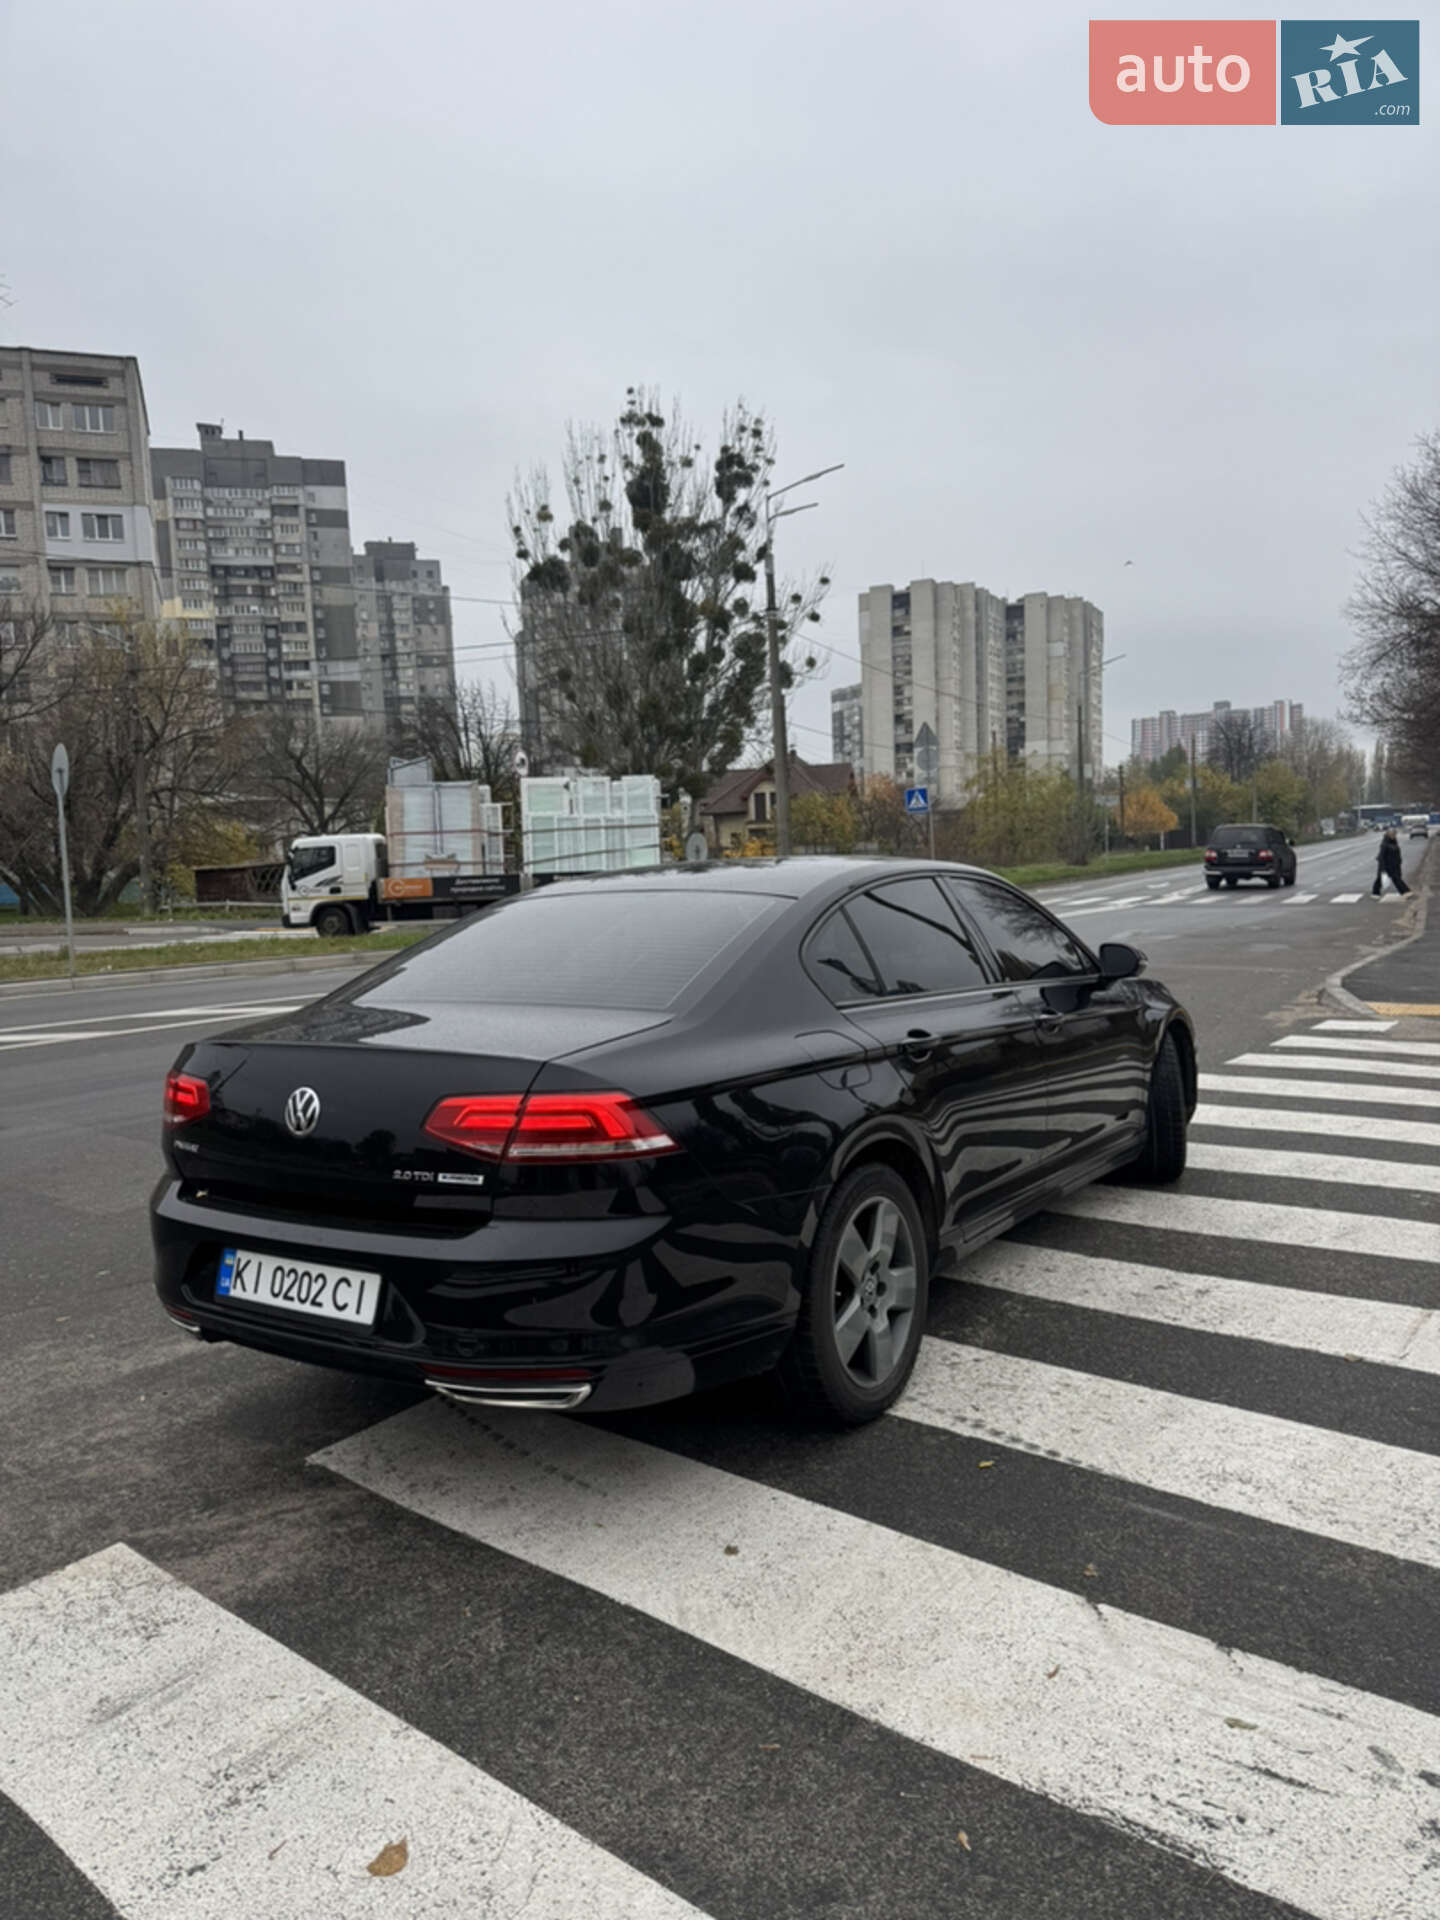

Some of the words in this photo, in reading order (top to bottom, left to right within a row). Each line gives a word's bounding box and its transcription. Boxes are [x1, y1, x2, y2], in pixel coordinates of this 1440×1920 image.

[233, 1257, 262, 1294] KI
[270, 1265, 328, 1308] 0202
[332, 1277, 366, 1315] CI
